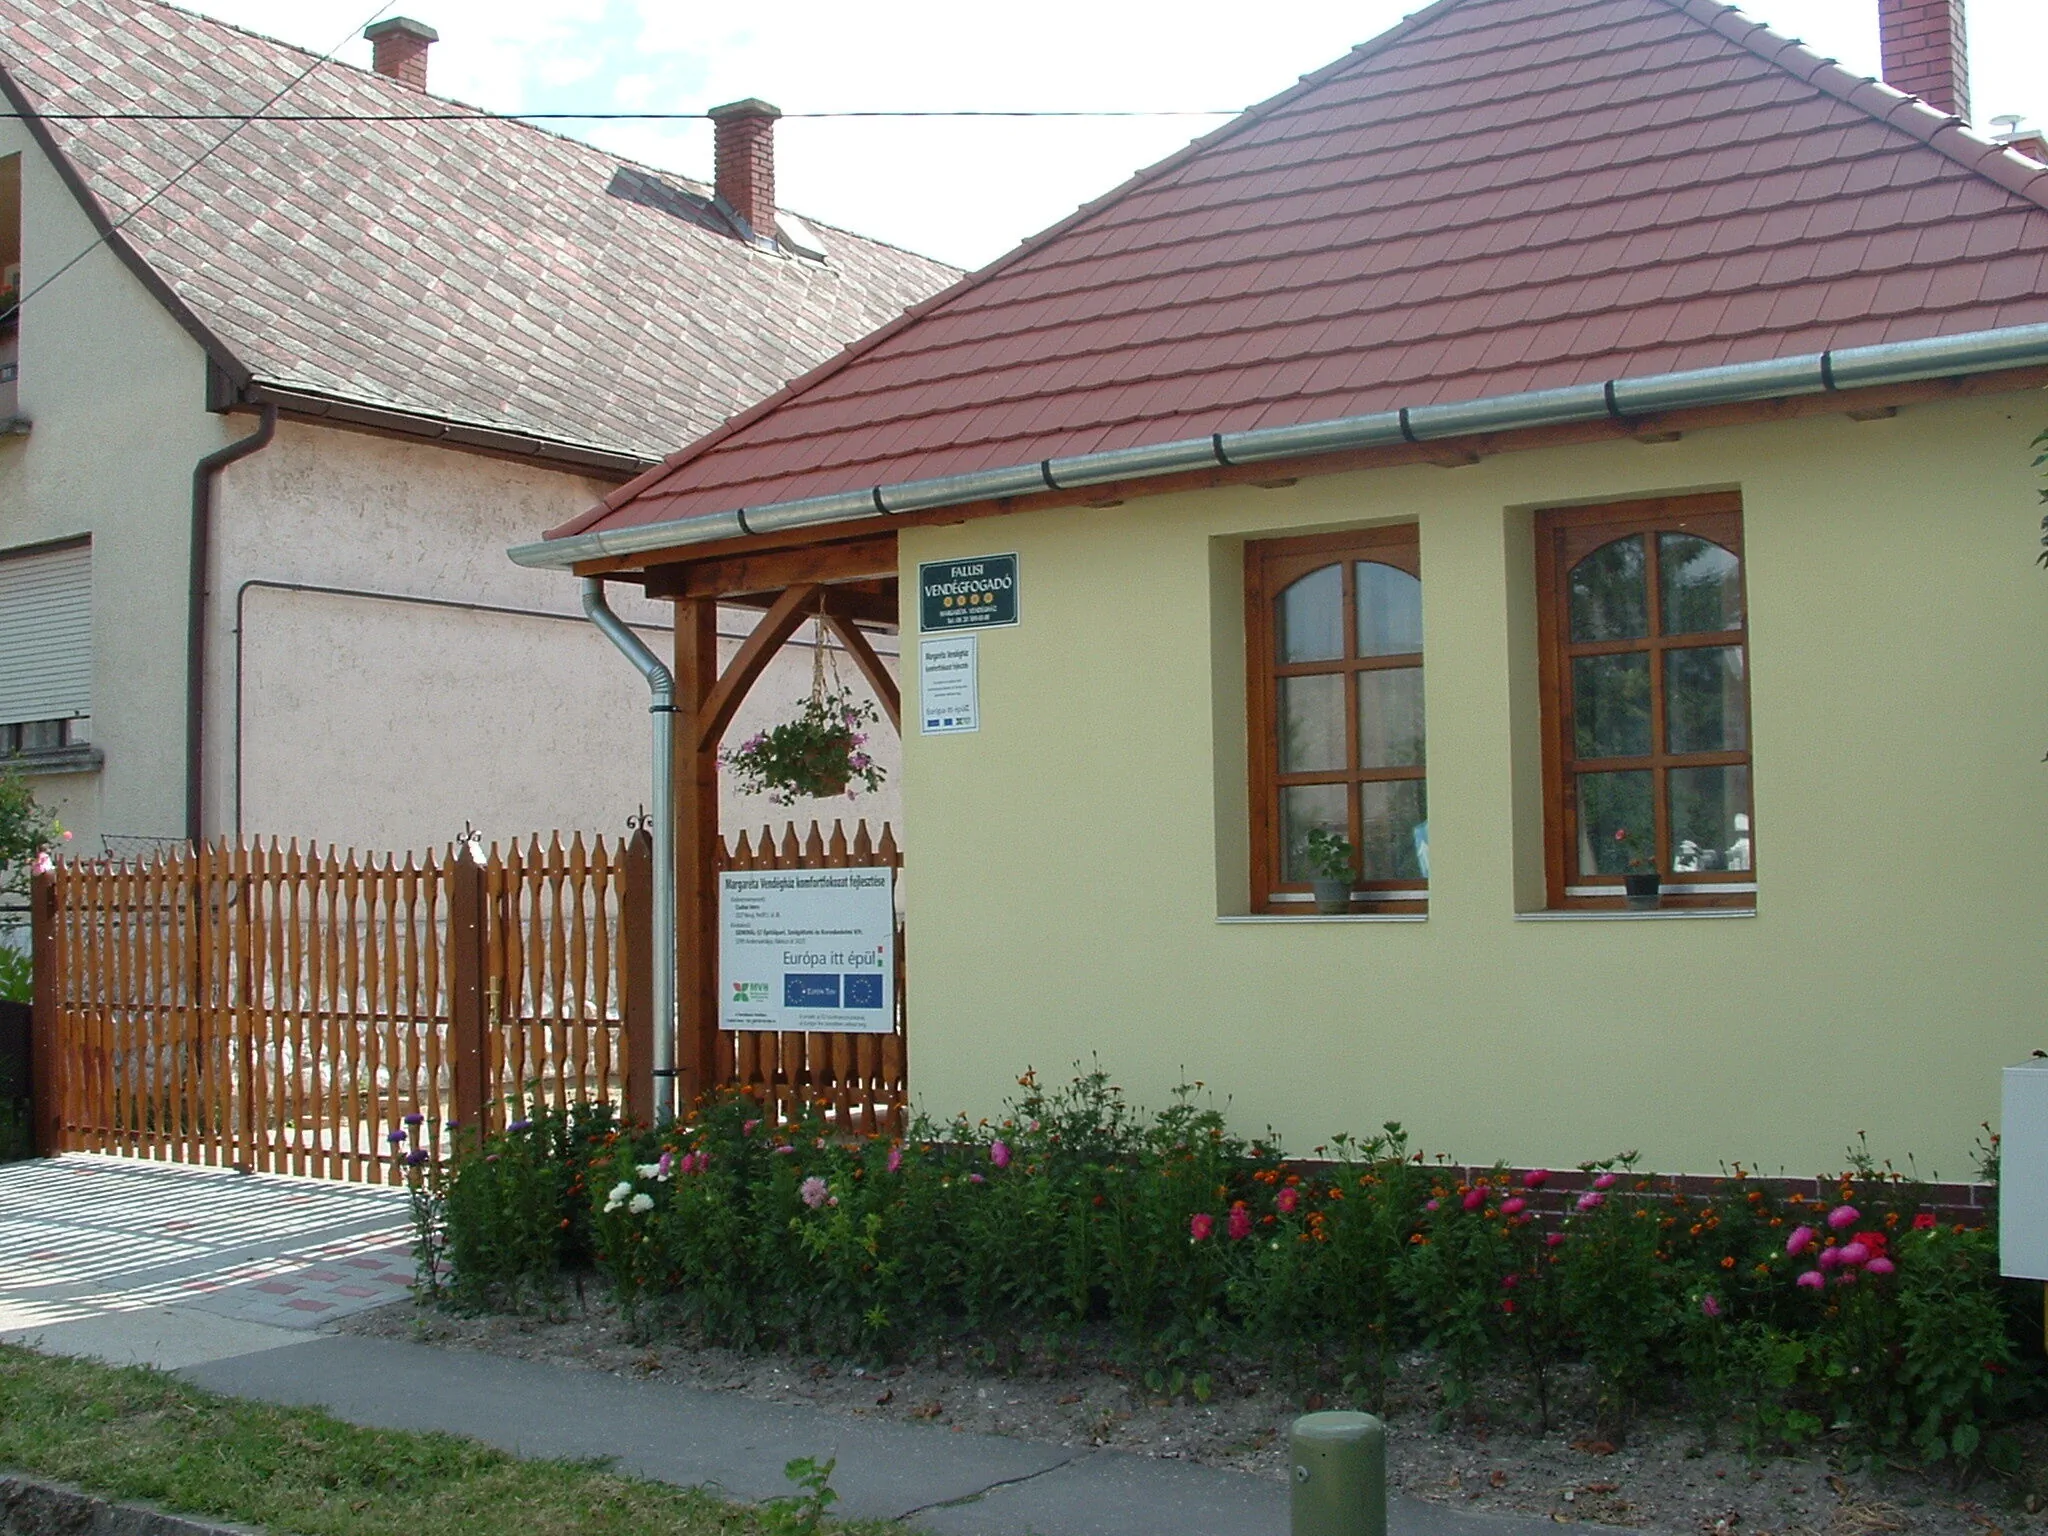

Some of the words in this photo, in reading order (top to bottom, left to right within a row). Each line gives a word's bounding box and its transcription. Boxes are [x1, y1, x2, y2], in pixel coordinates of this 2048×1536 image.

[951, 563, 984, 578] FALUSI
[924, 573, 1013, 597] VENDÉGFOGADÓ
[783, 951, 827, 969] Európa
[830, 951, 845, 966] itt
[847, 950, 876, 969] épül
